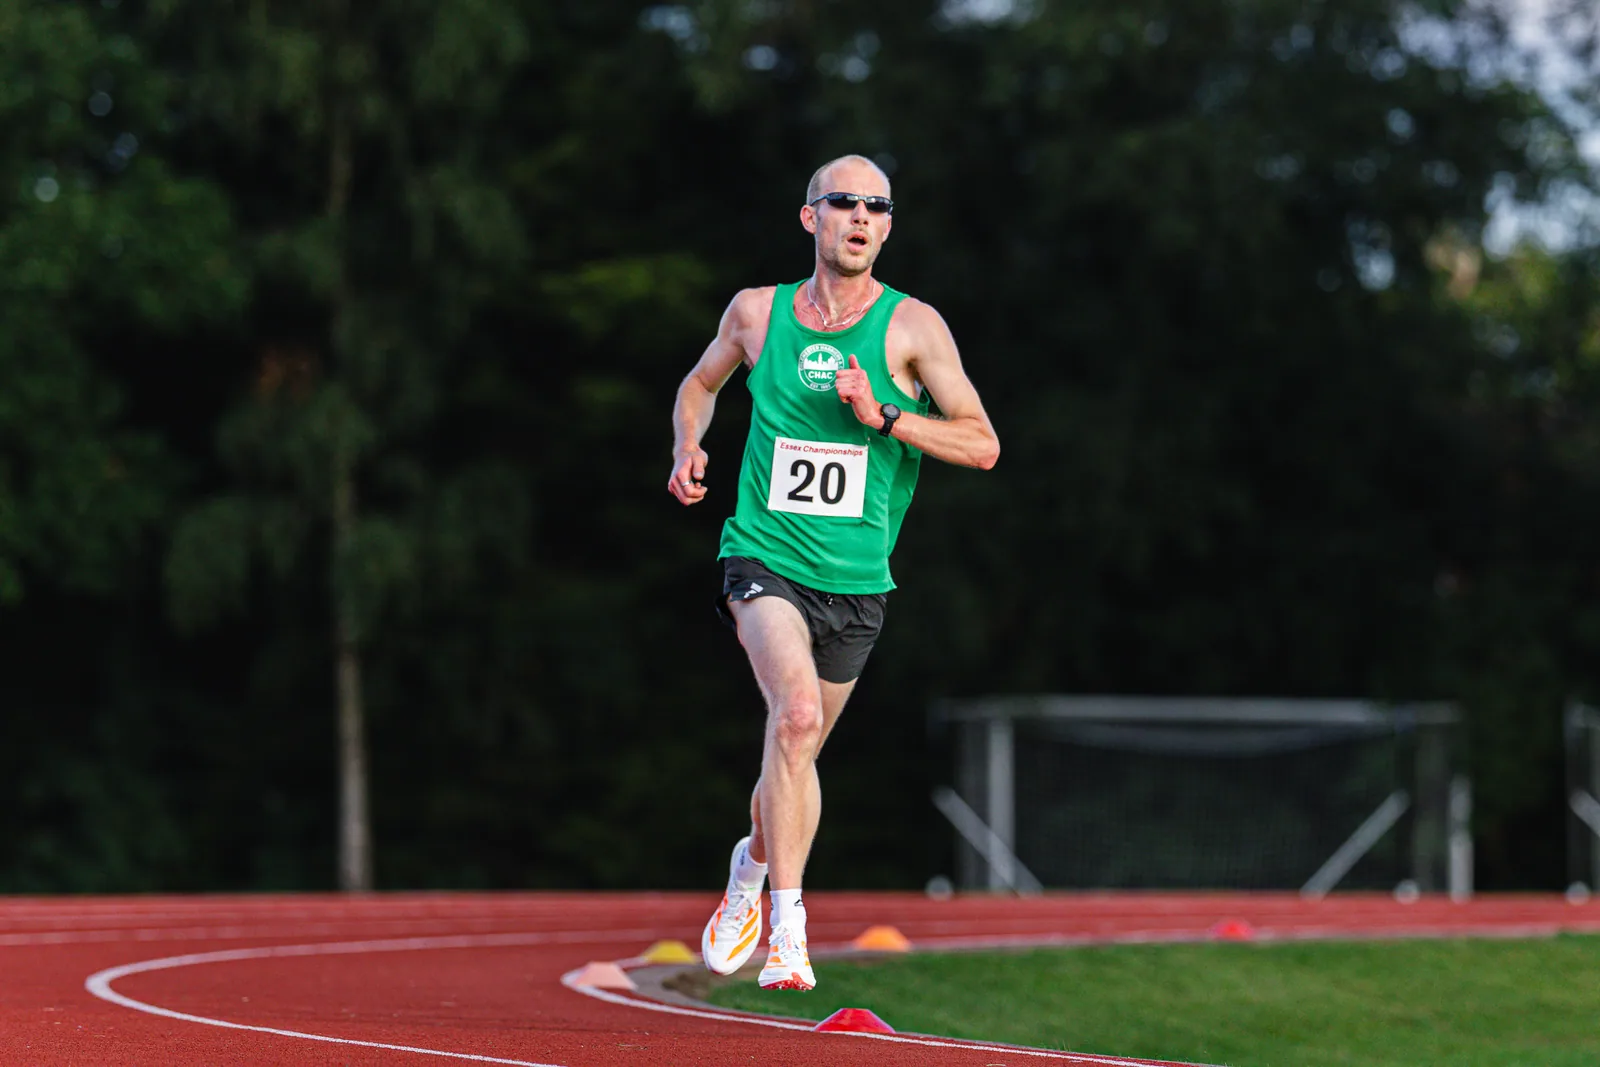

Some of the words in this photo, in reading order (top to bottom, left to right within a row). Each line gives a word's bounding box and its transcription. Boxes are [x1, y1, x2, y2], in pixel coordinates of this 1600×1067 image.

[808, 371, 833, 379] CHAC
[780, 442, 802, 451] Essex
[803, 445, 863, 457] Championships
[787, 459, 846, 505] 20
